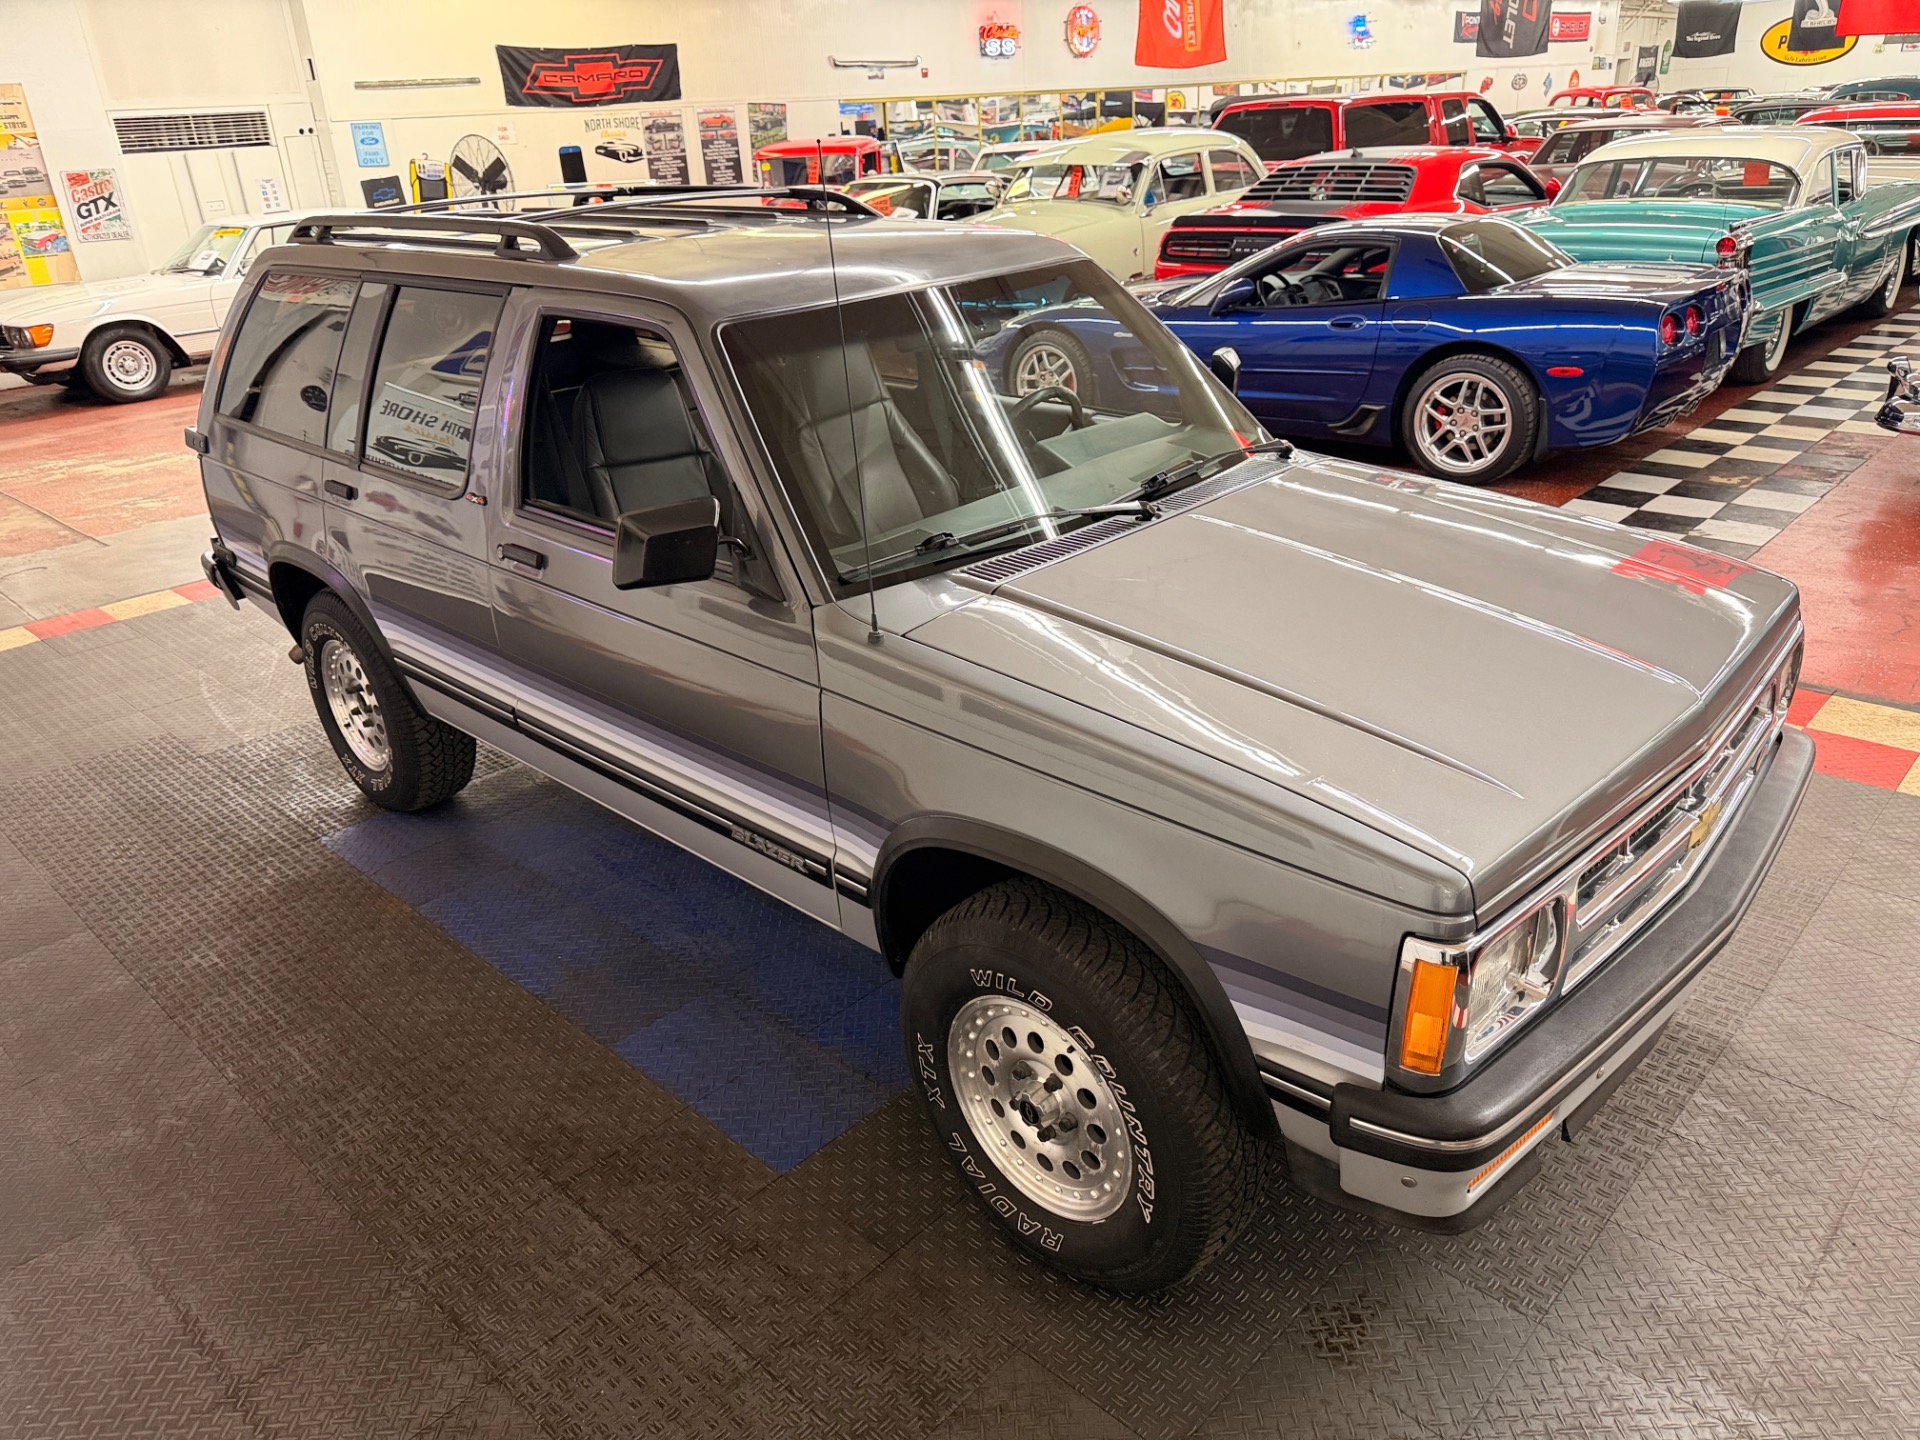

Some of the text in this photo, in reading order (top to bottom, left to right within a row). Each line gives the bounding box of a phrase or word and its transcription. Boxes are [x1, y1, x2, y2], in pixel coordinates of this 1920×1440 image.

[1560, 21, 1588, 33] SHELBY
[985, 38, 1016, 56] SS
[543, 69, 644, 84] CAMARO
[584, 116, 641, 133] NORTH SHORE
[76, 190, 118, 220] GTX
[305, 638, 319, 690] WILD
[731, 823, 809, 875] BLAZER
[969, 968, 1155, 1224] WILD COUNTRY
[917, 1032, 1064, 1252] RADIAL XTX
